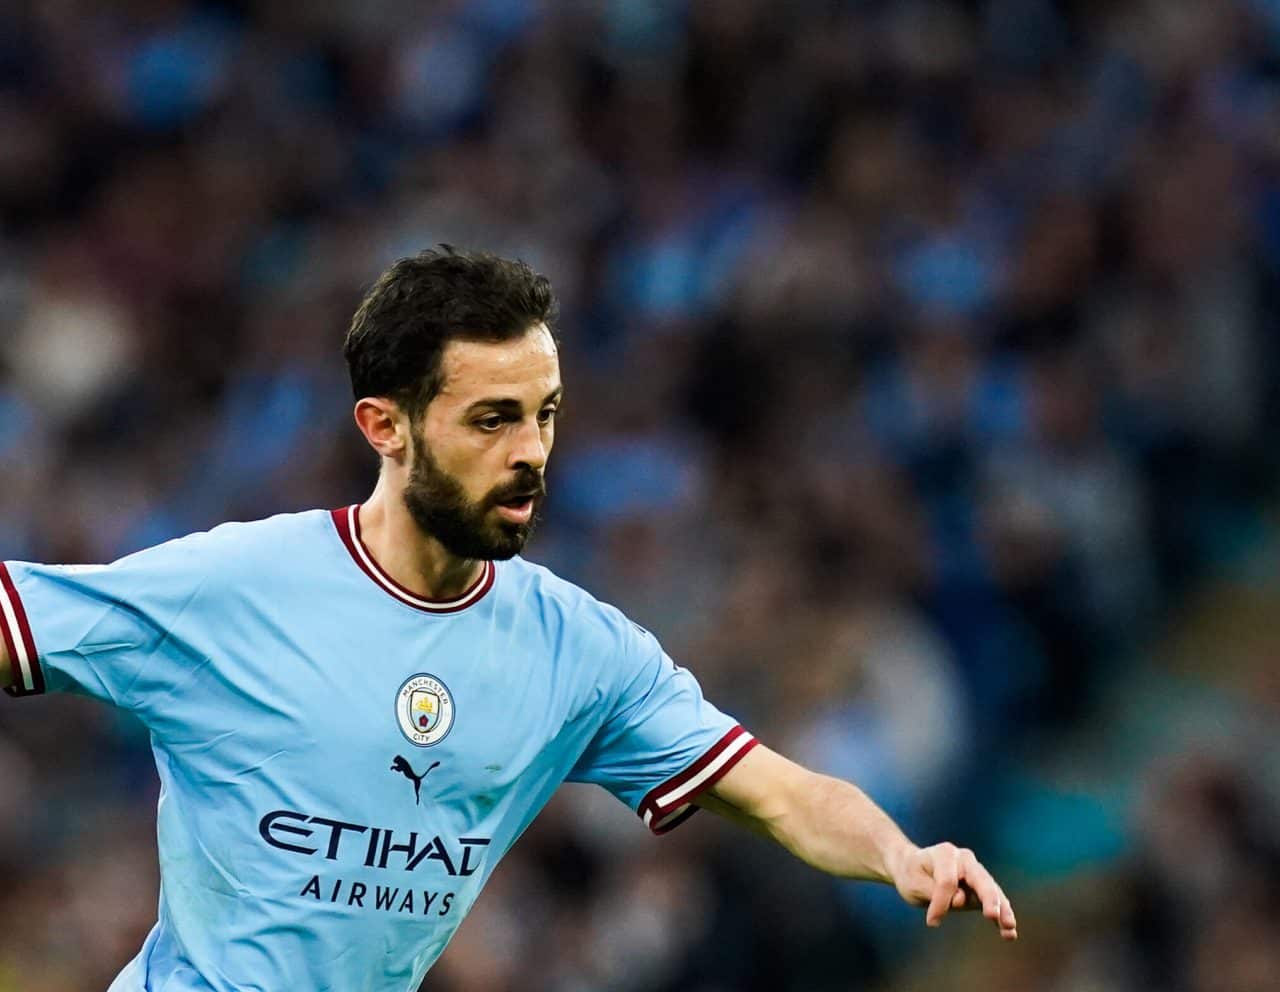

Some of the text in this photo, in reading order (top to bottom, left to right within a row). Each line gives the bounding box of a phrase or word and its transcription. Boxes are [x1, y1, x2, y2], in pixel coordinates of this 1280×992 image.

[402, 679, 448, 705] MANCHESTER
[413, 733, 430, 742] CITY
[258, 809, 492, 876] ETIHAD
[300, 874, 456, 916] AIRWAYS
